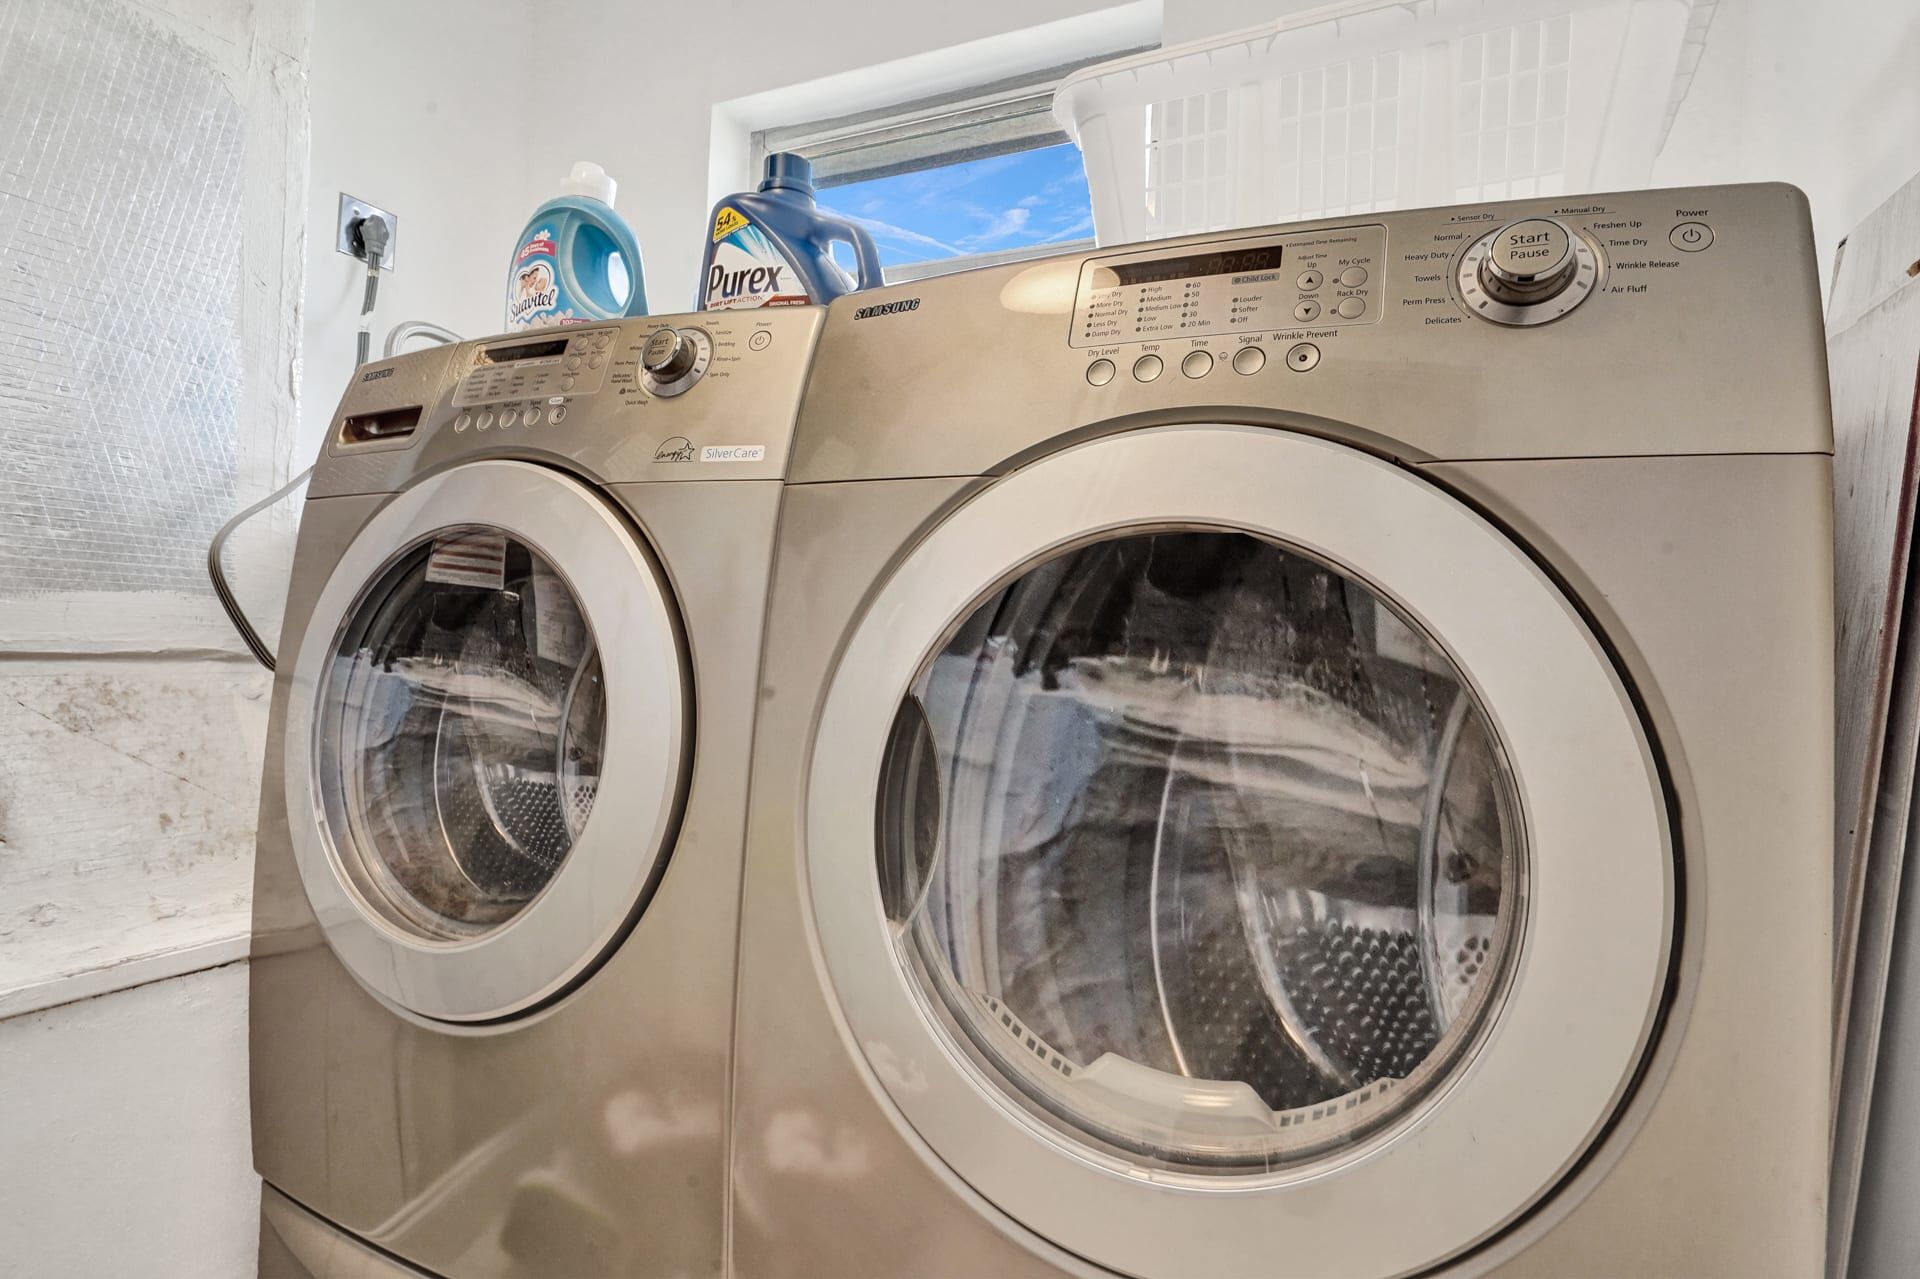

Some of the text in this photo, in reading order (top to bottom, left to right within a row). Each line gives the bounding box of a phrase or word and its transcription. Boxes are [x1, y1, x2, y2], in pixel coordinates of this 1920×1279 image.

[1592, 206, 1606, 214] Dry
[1675, 209, 1709, 217] Power
[1483, 213, 1495, 221] Dry
[1593, 220, 1642, 229] Freshen Up
[1434, 233, 1463, 241] Normal
[1510, 231, 1550, 245] Start
[1609, 238, 1648, 247] Time Dry
[1405, 251, 1449, 261] Heavy Duty
[1510, 249, 1550, 261] Pause
[1307, 261, 1317, 269] Up
[1338, 257, 1371, 267] My Cycle
[1616, 260, 1680, 270] Wrinkle Release
[1242, 273, 1277, 283] Child Lock
[1415, 274, 1441, 282] Towels
[707, 265, 783, 302] Purex
[1148, 286, 1162, 294] High
[1337, 288, 1369, 298] Rack Dry
[1627, 285, 1648, 293] Fluff
[1112, 290, 1122, 298] Dry
[1239, 294, 1263, 303] Louder
[1299, 292, 1319, 300] Down
[511, 289, 556, 320] Suavitel
[1113, 300, 1123, 308] Dry
[1403, 297, 1446, 306] Perm Press
[854, 298, 921, 320] SAMSUNG
[1145, 304, 1169, 312] Medium
[1238, 305, 1259, 313] Softer
[1094, 308, 1128, 318] Normal Dry
[1107, 319, 1118, 327] Dry
[1425, 316, 1462, 325] Delicates
[1092, 328, 1121, 338] Damp Dry
[1273, 329, 1338, 341] Wrinkle Prevent
[650, 338, 670, 347] Start
[1191, 339, 1209, 348] Time
[1238, 334, 1263, 345] Signal
[1088, 347, 1120, 358] Dry Level
[1141, 344, 1160, 353] Temp
[705, 447, 760, 460] SilverCare
